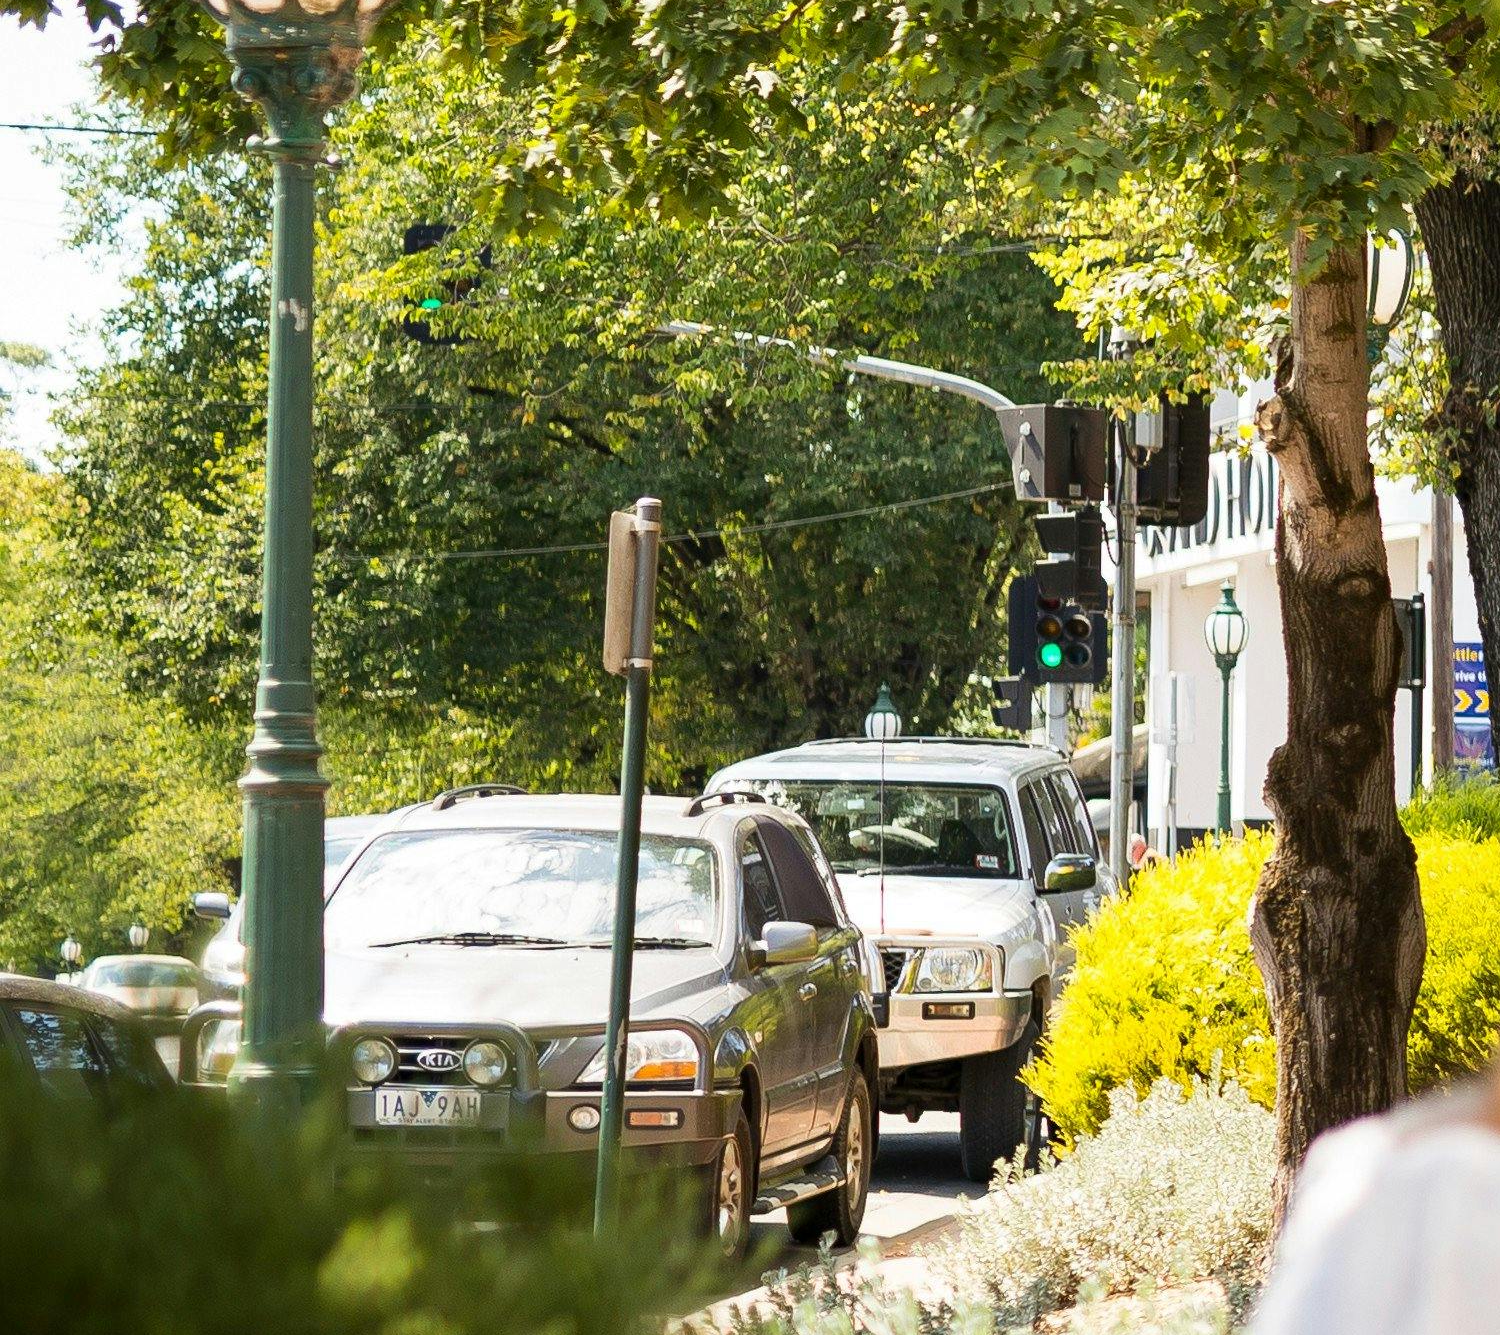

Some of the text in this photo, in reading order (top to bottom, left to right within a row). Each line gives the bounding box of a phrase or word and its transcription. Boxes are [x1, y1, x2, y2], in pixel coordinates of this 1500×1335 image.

[425, 1054, 454, 1066] KIA
[382, 1094, 478, 1119] 1AJ 9AH
